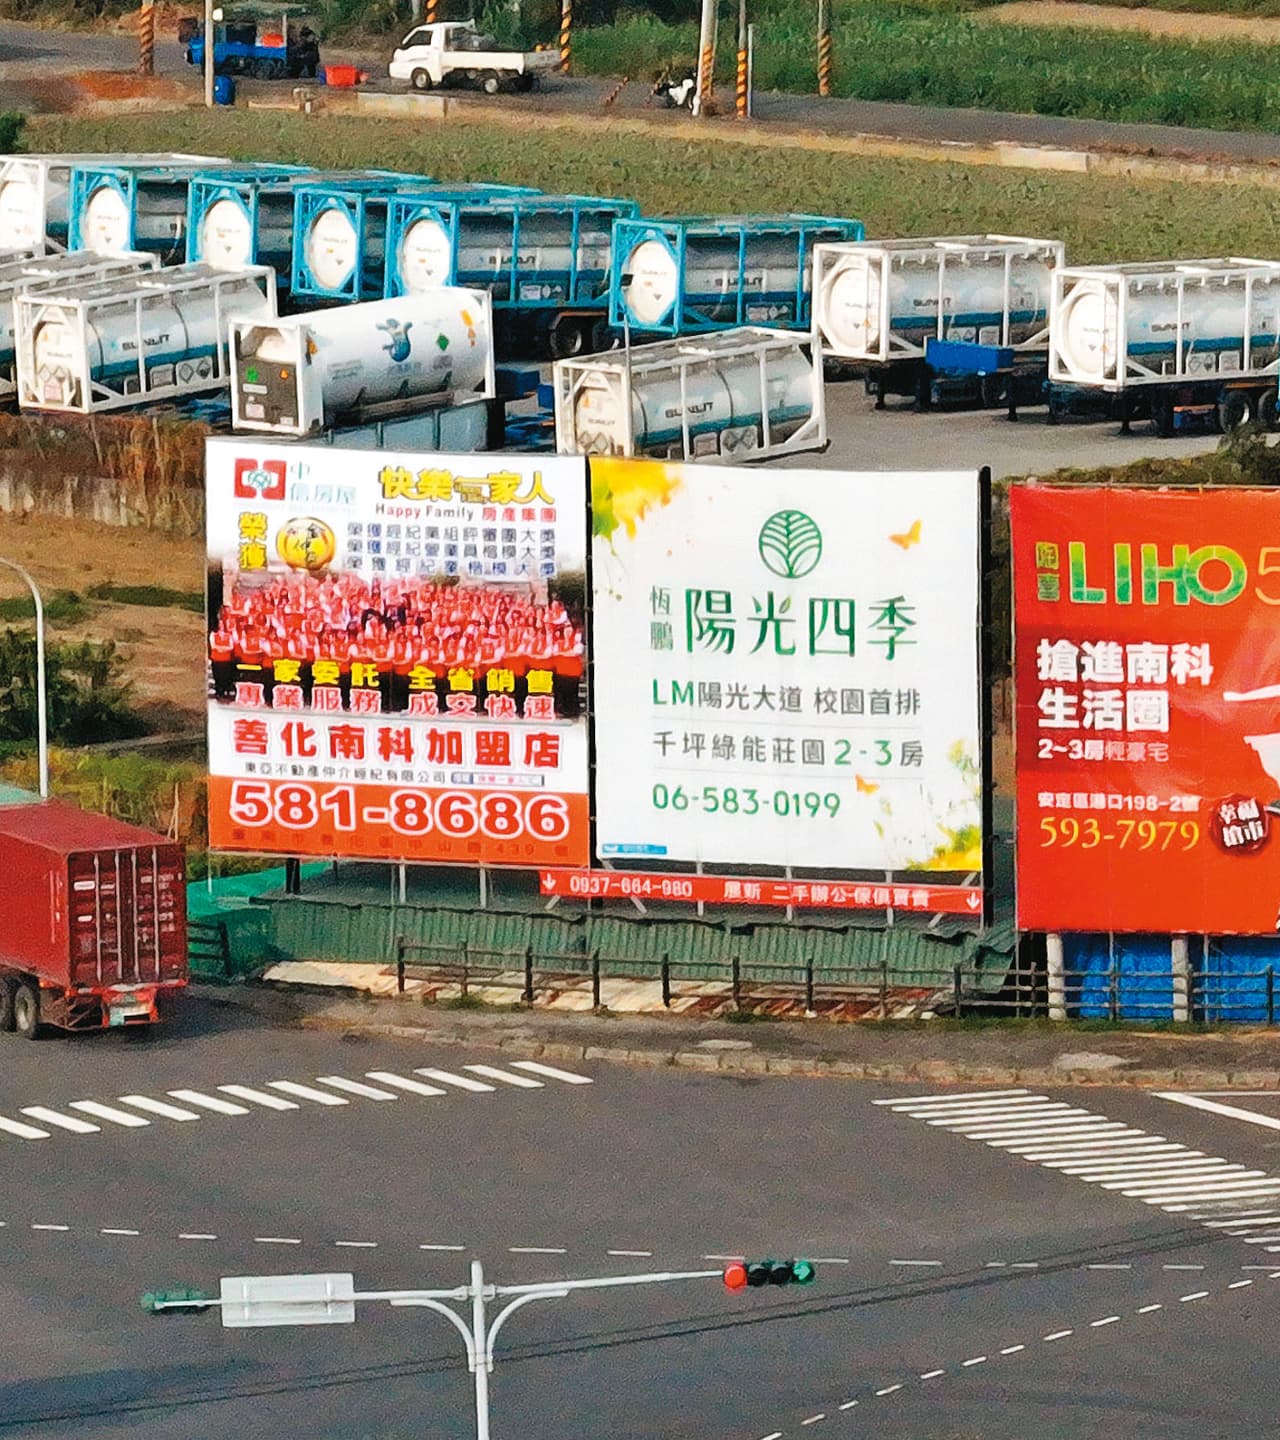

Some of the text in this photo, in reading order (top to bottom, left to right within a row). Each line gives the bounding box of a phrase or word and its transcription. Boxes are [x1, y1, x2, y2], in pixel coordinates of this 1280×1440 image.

[375, 504, 422, 519] Happy
[426, 504, 475, 521] Family
[684, 587, 918, 661] 陽光四季
[1037, 638, 1214, 686] 搶進南科
[813, 685, 921, 717] 校園首排
[1037, 687, 1171, 733] 生活圈
[232, 718, 561, 770] 善化南科加盟店
[229, 781, 570, 842] 581-8686
[652, 784, 842, 819] 06-583-0199
[1039, 816, 1201, 852] 593-7979
